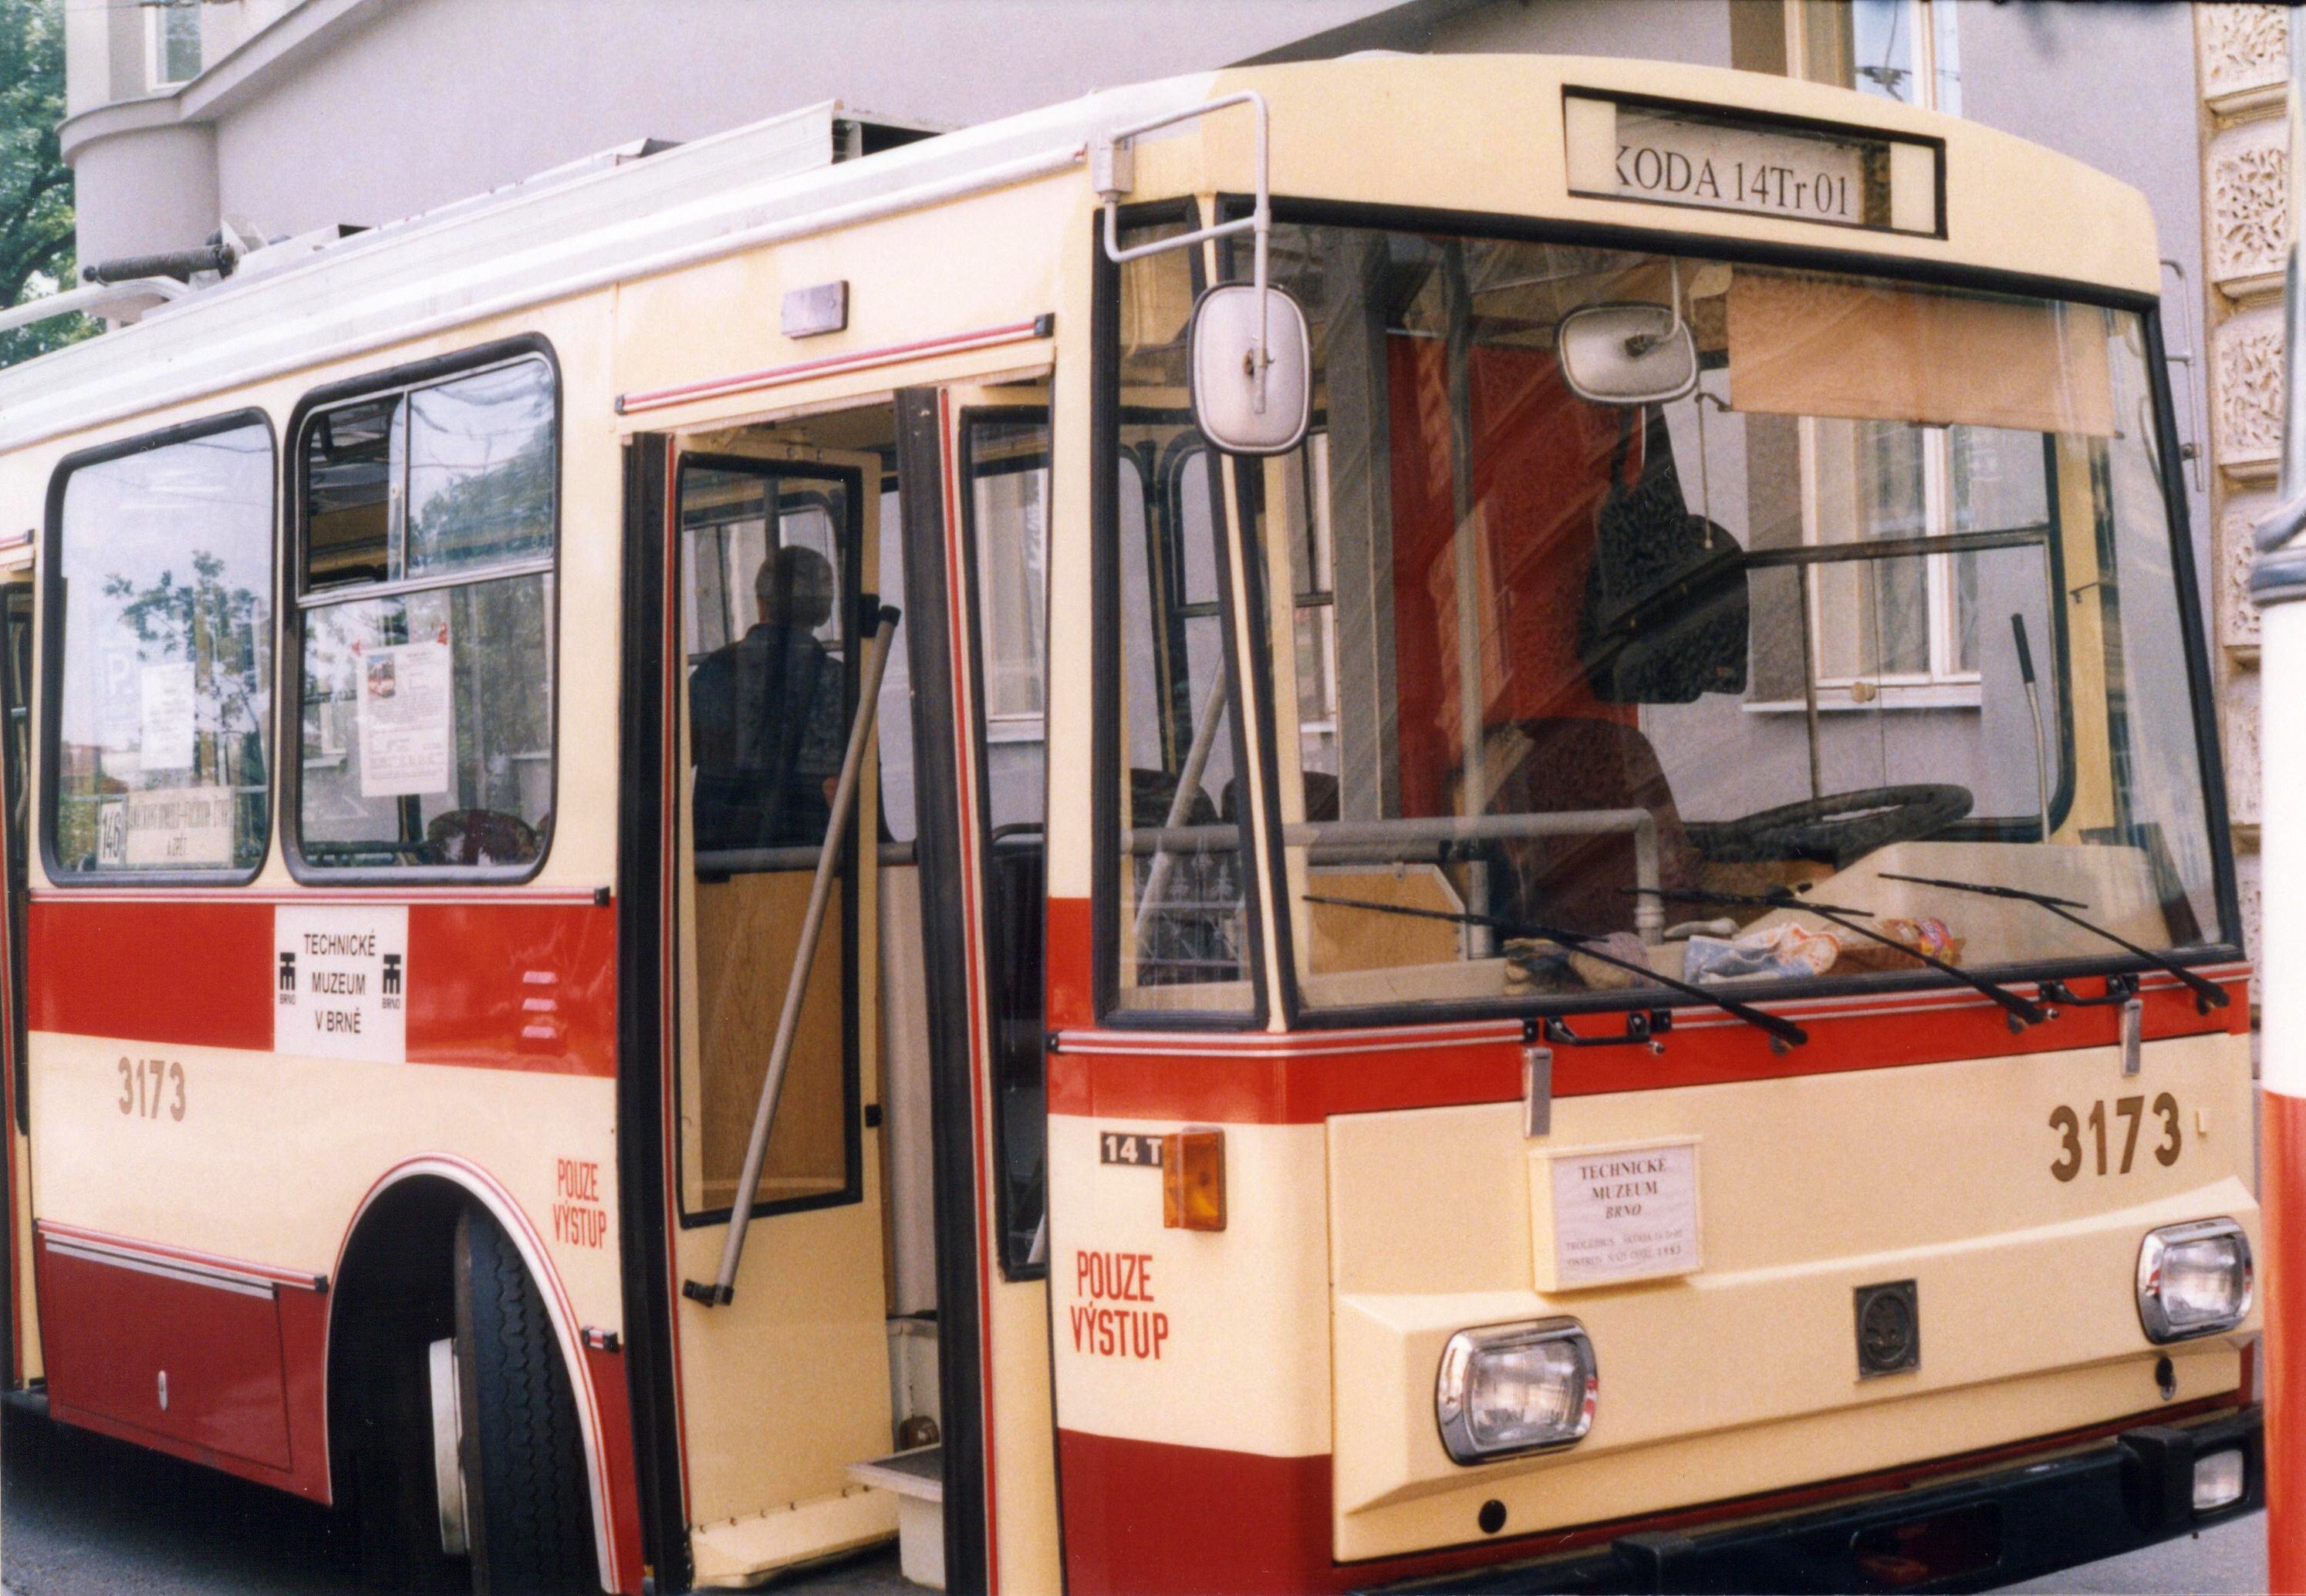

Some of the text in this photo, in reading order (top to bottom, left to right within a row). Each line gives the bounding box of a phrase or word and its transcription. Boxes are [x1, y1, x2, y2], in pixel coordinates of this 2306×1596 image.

[304, 930, 376, 957] TECHNICKÉ
[312, 971, 366, 995] MUZEUM
[279, 994, 295, 1005] BRNO
[382, 998, 400, 1010] BRNO
[315, 1007, 361, 1034] V BRNĚ
[118, 1056, 187, 1122] 3173
[1105, 1135, 1138, 1163] 14
[2048, 1092, 2182, 1183] 3173
[558, 1159, 599, 1202] POUZE
[1580, 1157, 1666, 1179] TECHNICKÉ
[1592, 1180, 1657, 1200] MUZEUM
[553, 1200, 607, 1249] VÝSTUP
[1605, 1203, 1642, 1220] BRNO
[1077, 1250, 1154, 1302] POUZE
[1070, 1301, 1169, 1360] VÝSTUP
